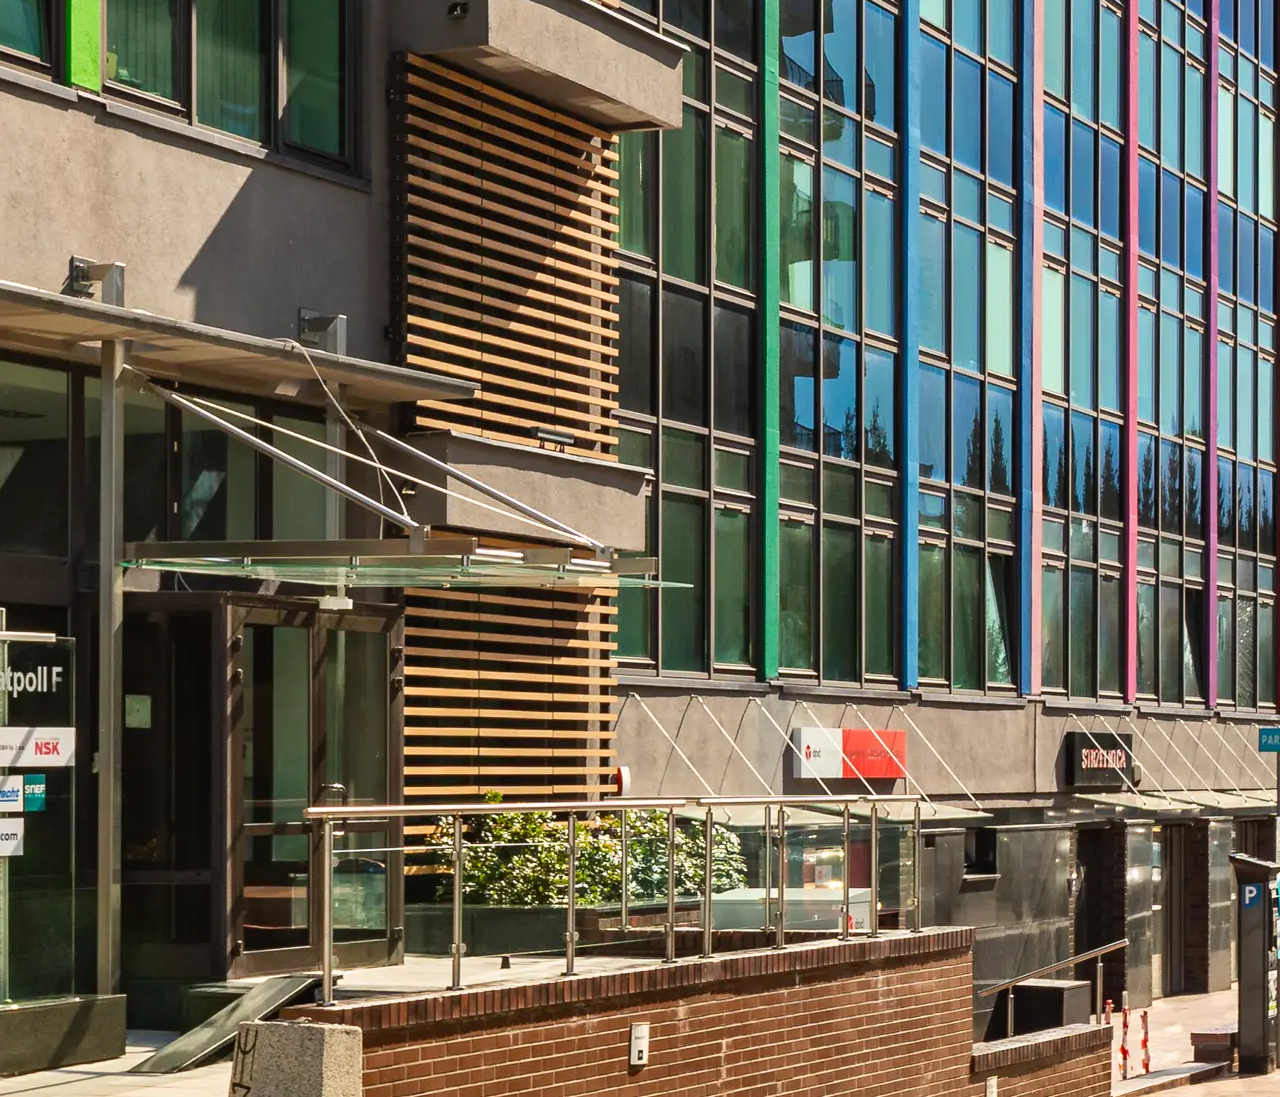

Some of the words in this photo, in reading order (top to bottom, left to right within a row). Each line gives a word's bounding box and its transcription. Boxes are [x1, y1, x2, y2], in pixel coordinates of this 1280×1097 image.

[52, 666, 63, 692] F
[34, 741, 60, 755] NSK
[1245, 886, 1257, 904] P
